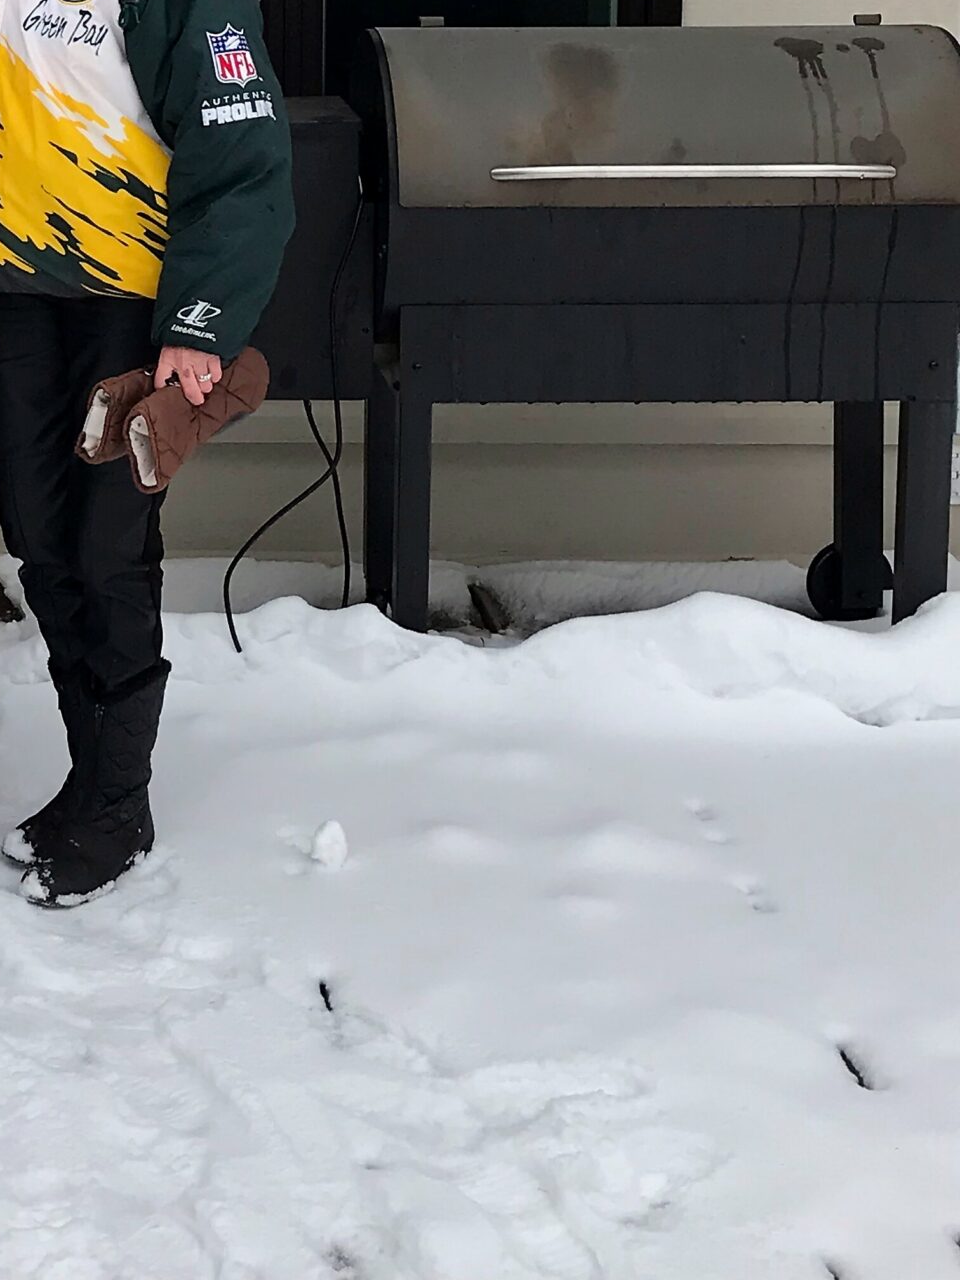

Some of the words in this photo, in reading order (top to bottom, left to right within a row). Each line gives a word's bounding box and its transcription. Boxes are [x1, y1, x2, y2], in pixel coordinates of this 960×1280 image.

[68, 9, 108, 56] Bay
[218, 51, 255, 79] NFL
[202, 91, 271, 107] AUTHENTC
